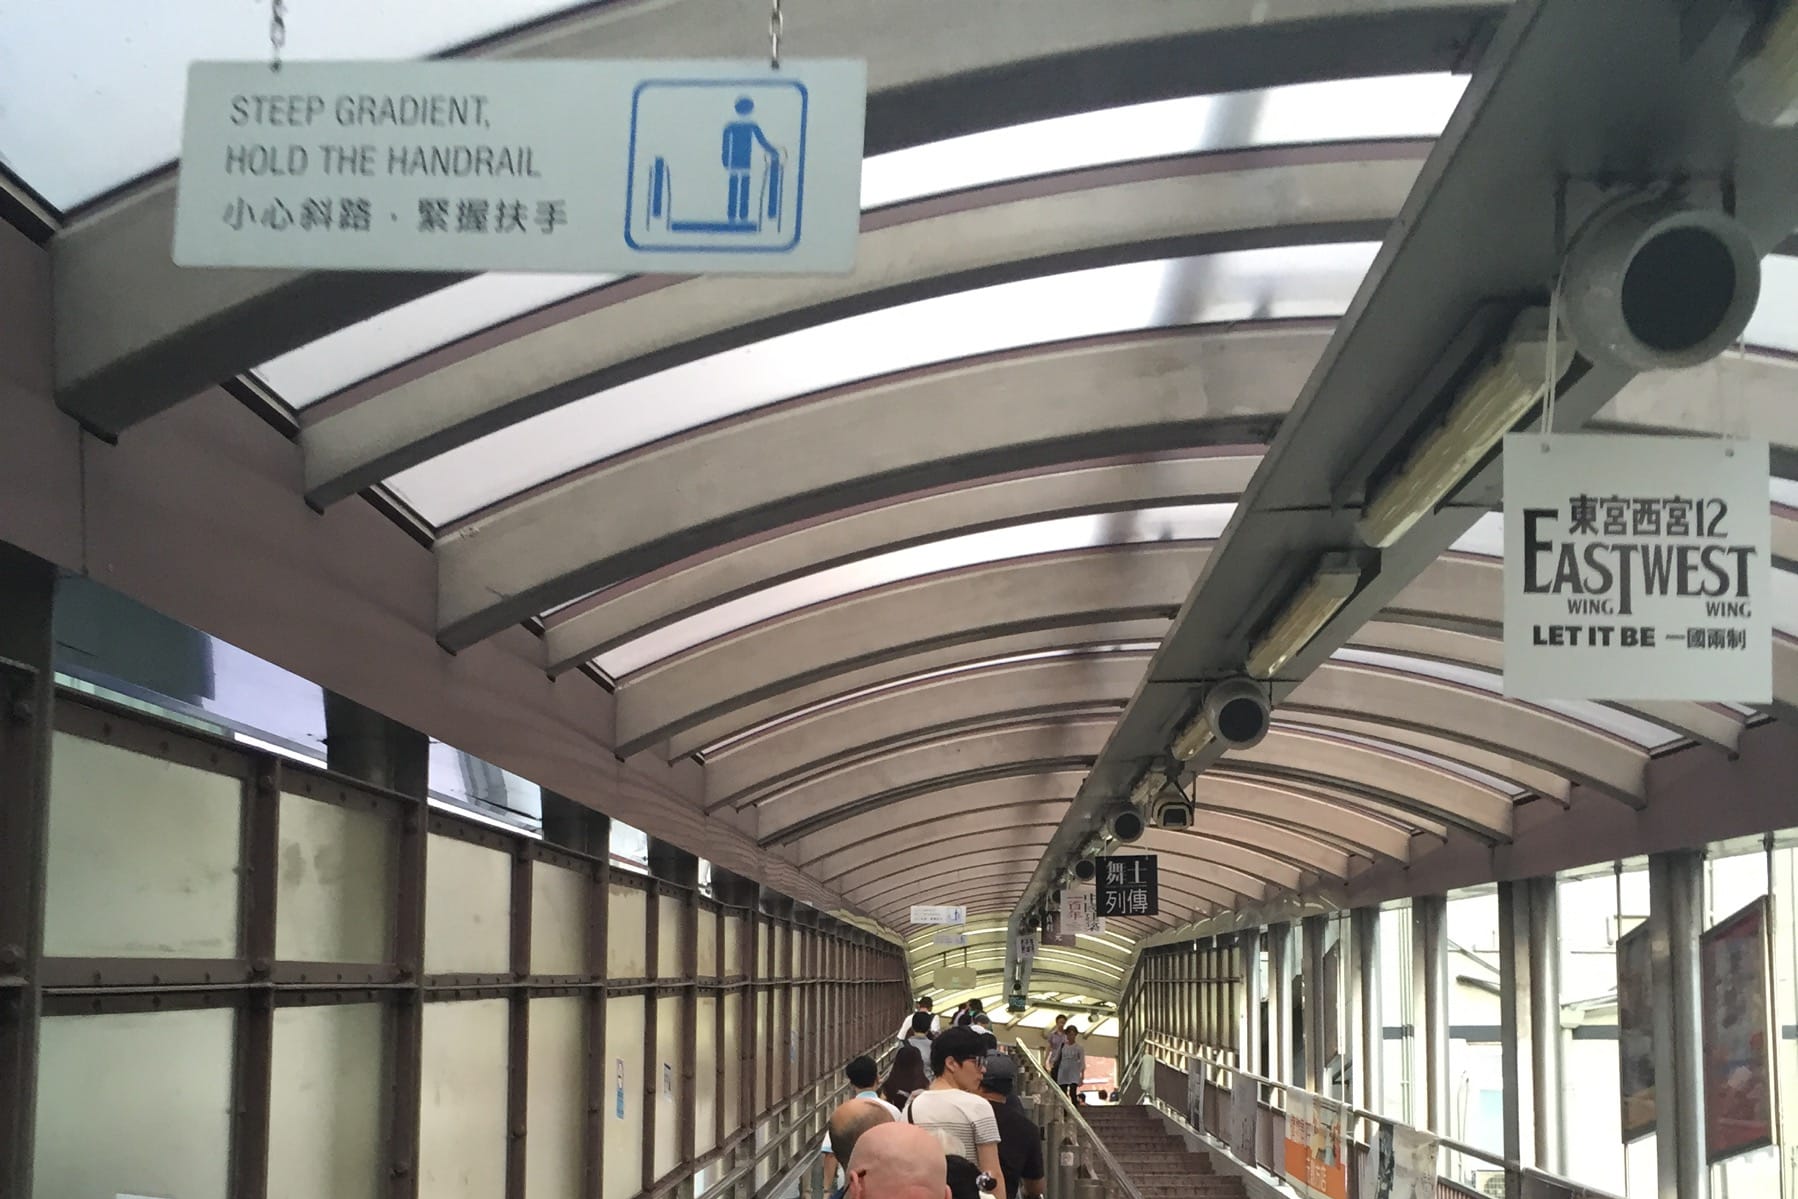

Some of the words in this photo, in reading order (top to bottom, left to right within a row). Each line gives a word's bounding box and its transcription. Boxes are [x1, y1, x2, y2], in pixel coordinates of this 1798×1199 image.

[230, 95, 325, 128] STEEP
[335, 95, 491, 129] GRADIENT,
[224, 144, 308, 177] HOLD
[319, 144, 377, 177] THE
[387, 145, 542, 178] HANDRAIL
[1567, 599, 1614, 616] WING
[1705, 601, 1752, 618] WING
[1533, 625, 1583, 647] LET
[1588, 626, 1615, 647] IT
[1620, 627, 1656, 648] BE
[1105, 889, 1148, 914] 列傳
